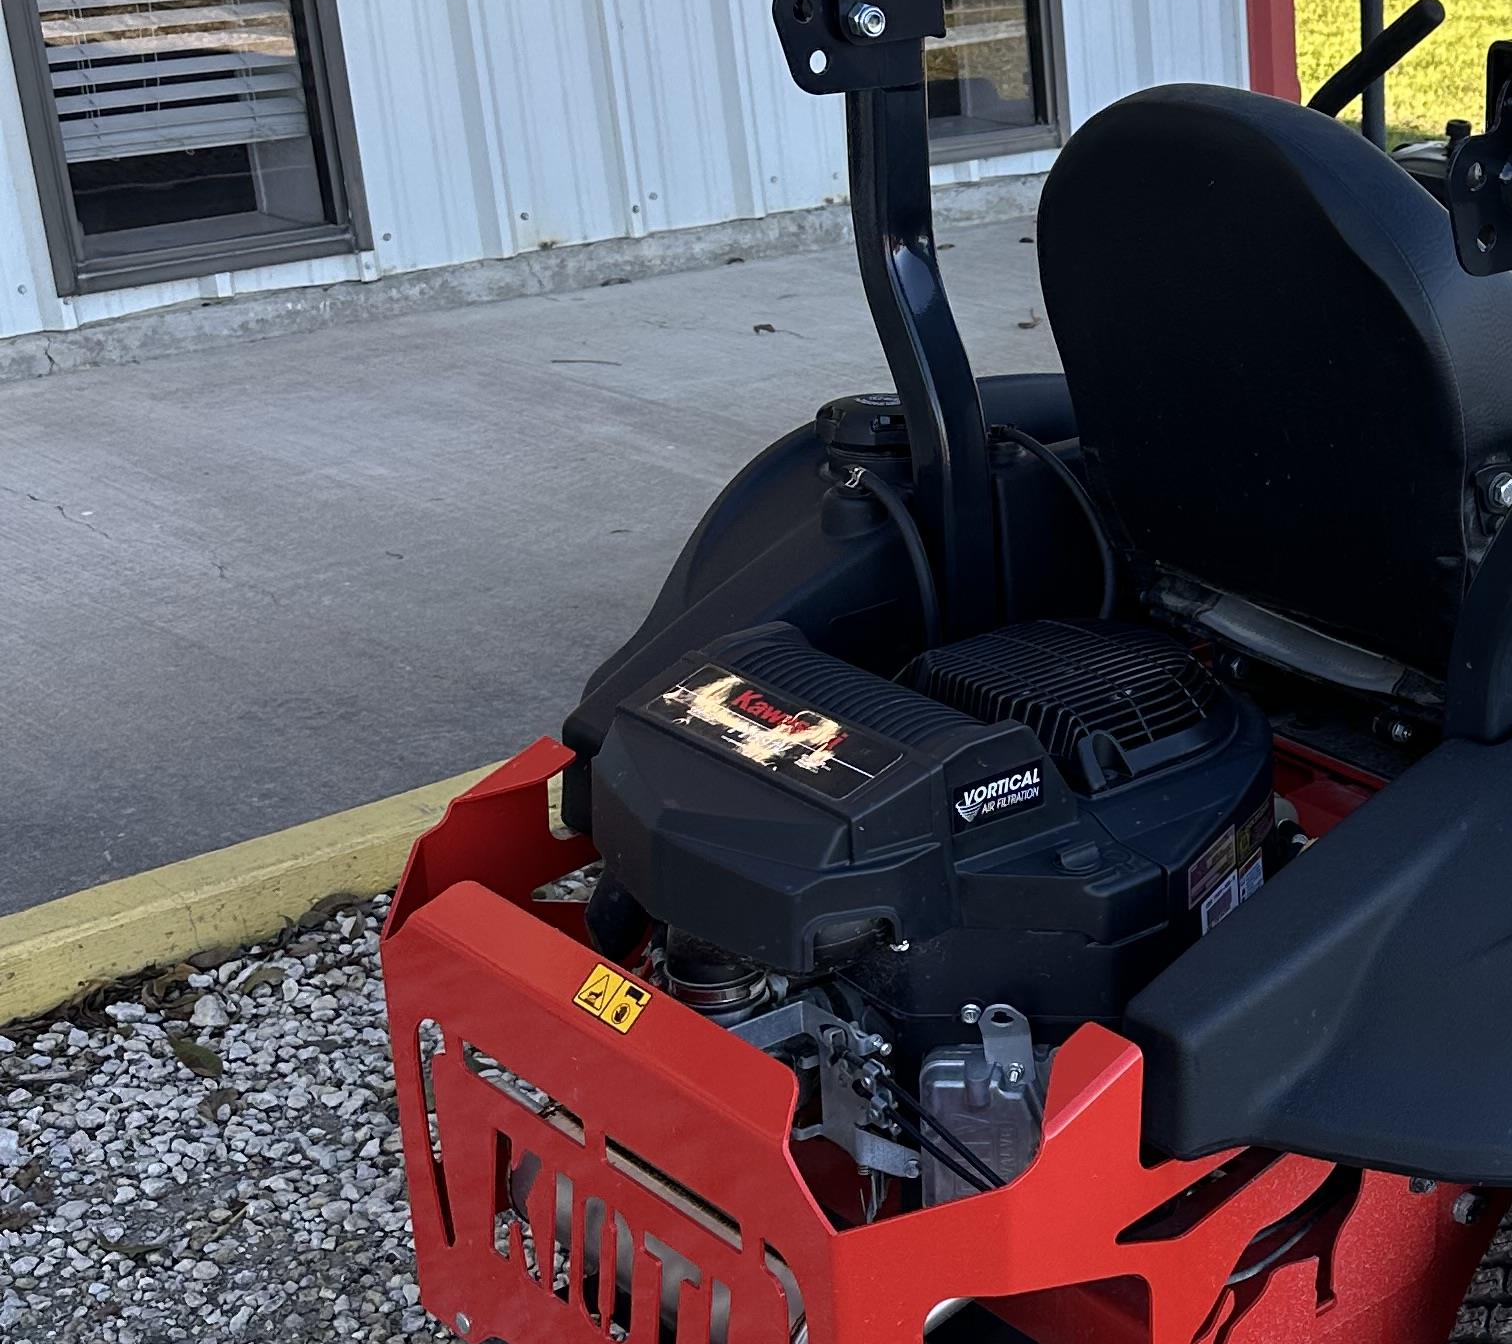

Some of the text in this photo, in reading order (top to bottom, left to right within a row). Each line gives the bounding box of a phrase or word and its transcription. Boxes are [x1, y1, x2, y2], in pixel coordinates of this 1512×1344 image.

[963, 767, 1040, 806] VORTICAL
[981, 786, 1040, 815] AIR FILTRATION
